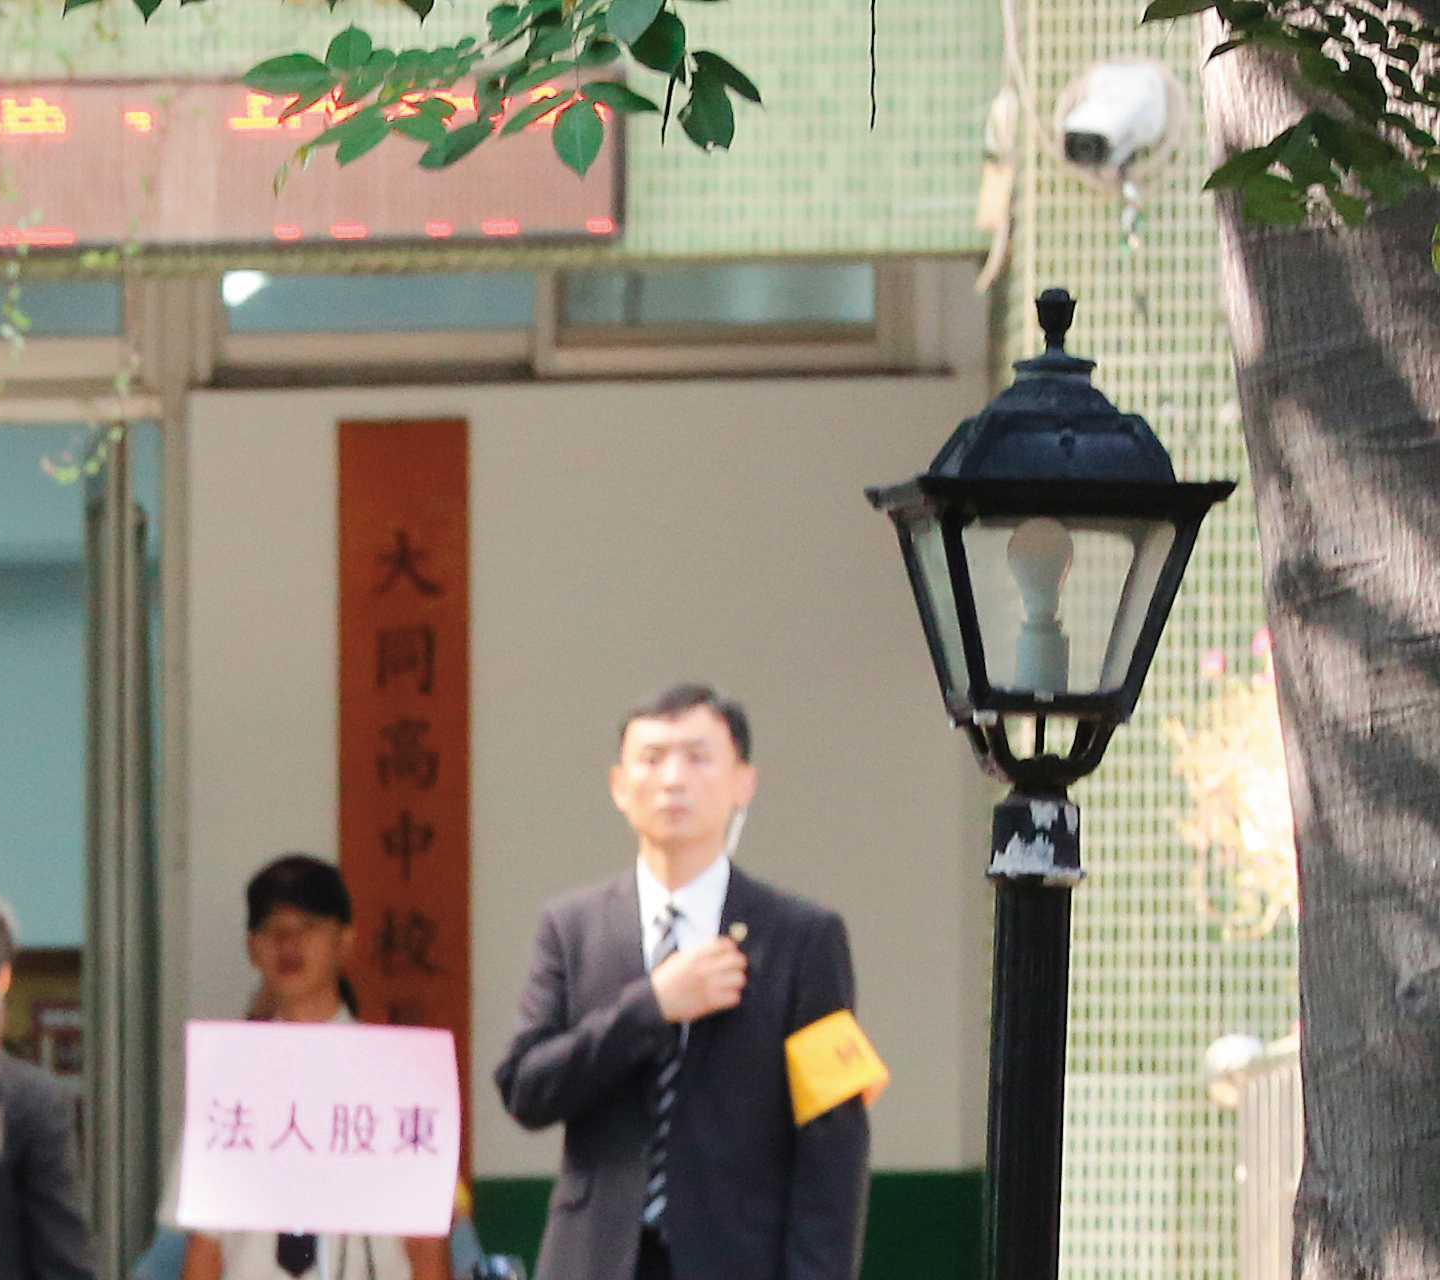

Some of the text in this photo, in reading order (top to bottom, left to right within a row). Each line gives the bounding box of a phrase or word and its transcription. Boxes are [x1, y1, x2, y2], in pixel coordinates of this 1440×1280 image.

[371, 528, 445, 1022] 大同高中校
[206, 1098, 442, 1157] 法人股東
